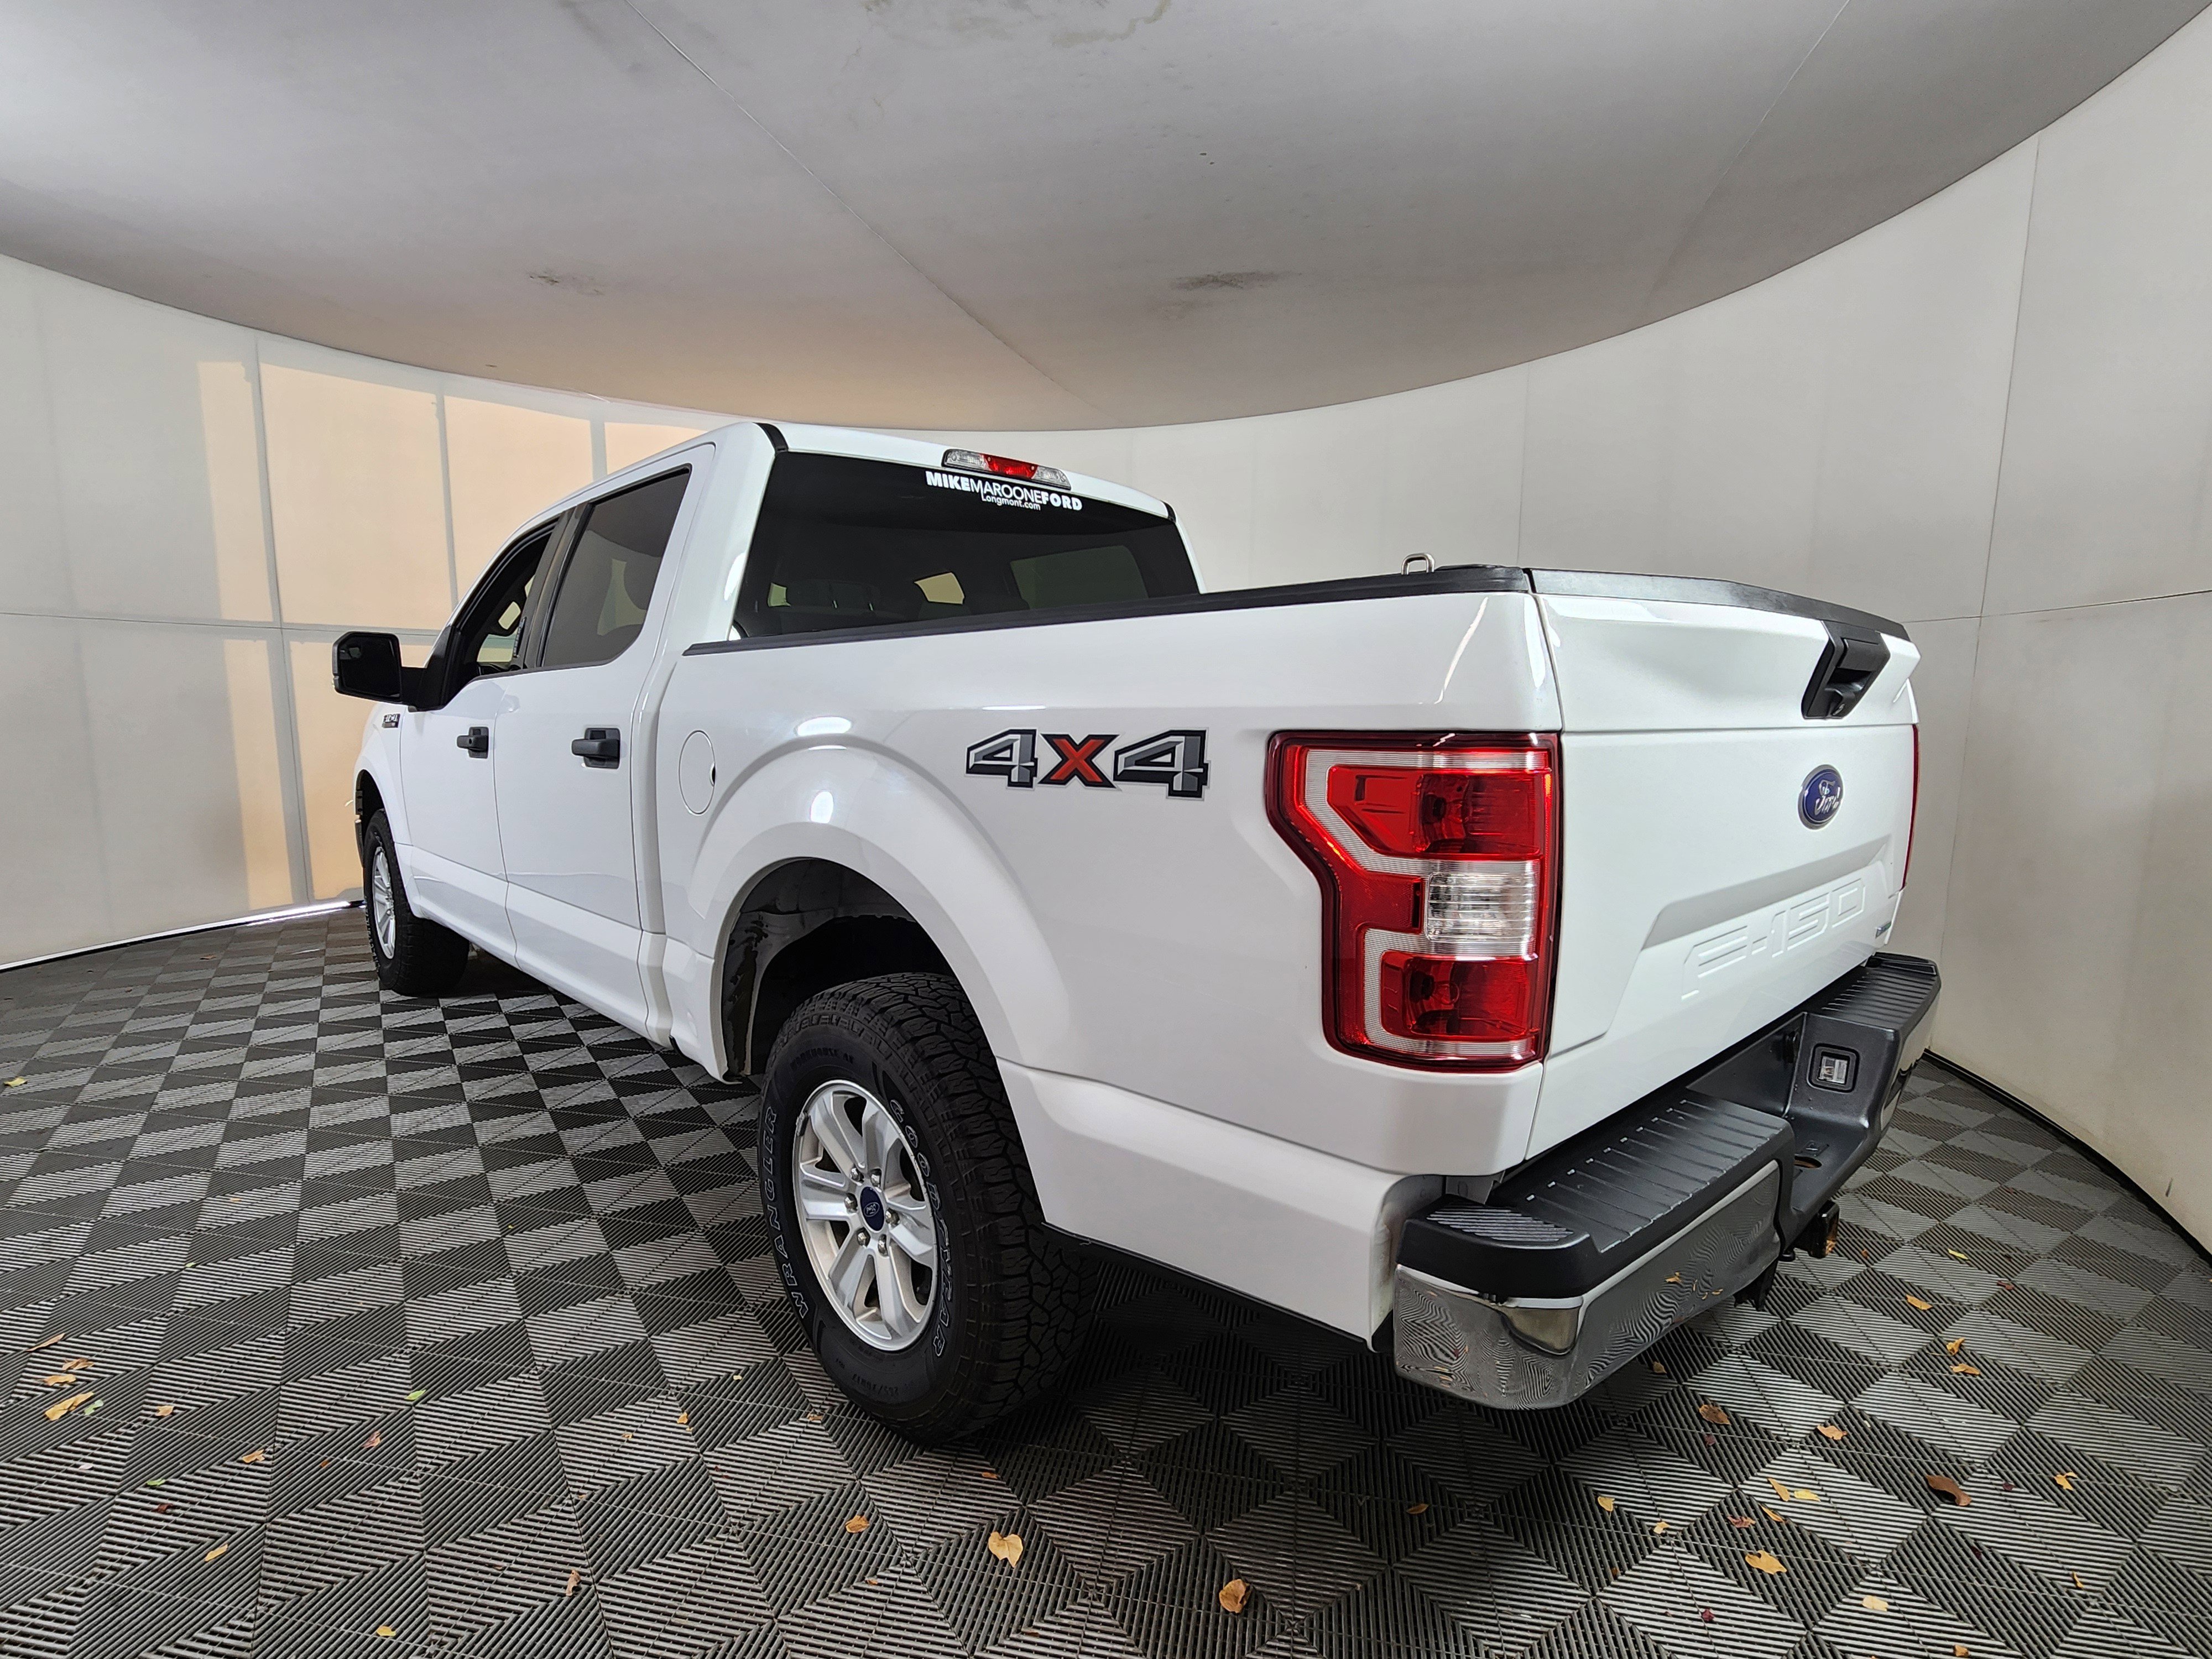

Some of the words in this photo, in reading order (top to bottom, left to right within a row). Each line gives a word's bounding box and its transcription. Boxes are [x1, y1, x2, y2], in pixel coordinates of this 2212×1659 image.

[981, 489, 1041, 510] Longmont.com
[1681, 877, 1866, 1001] F-150
[763, 1105, 809, 1319] WRANGLER
[889, 1098, 952, 1358] GOODYEAR
